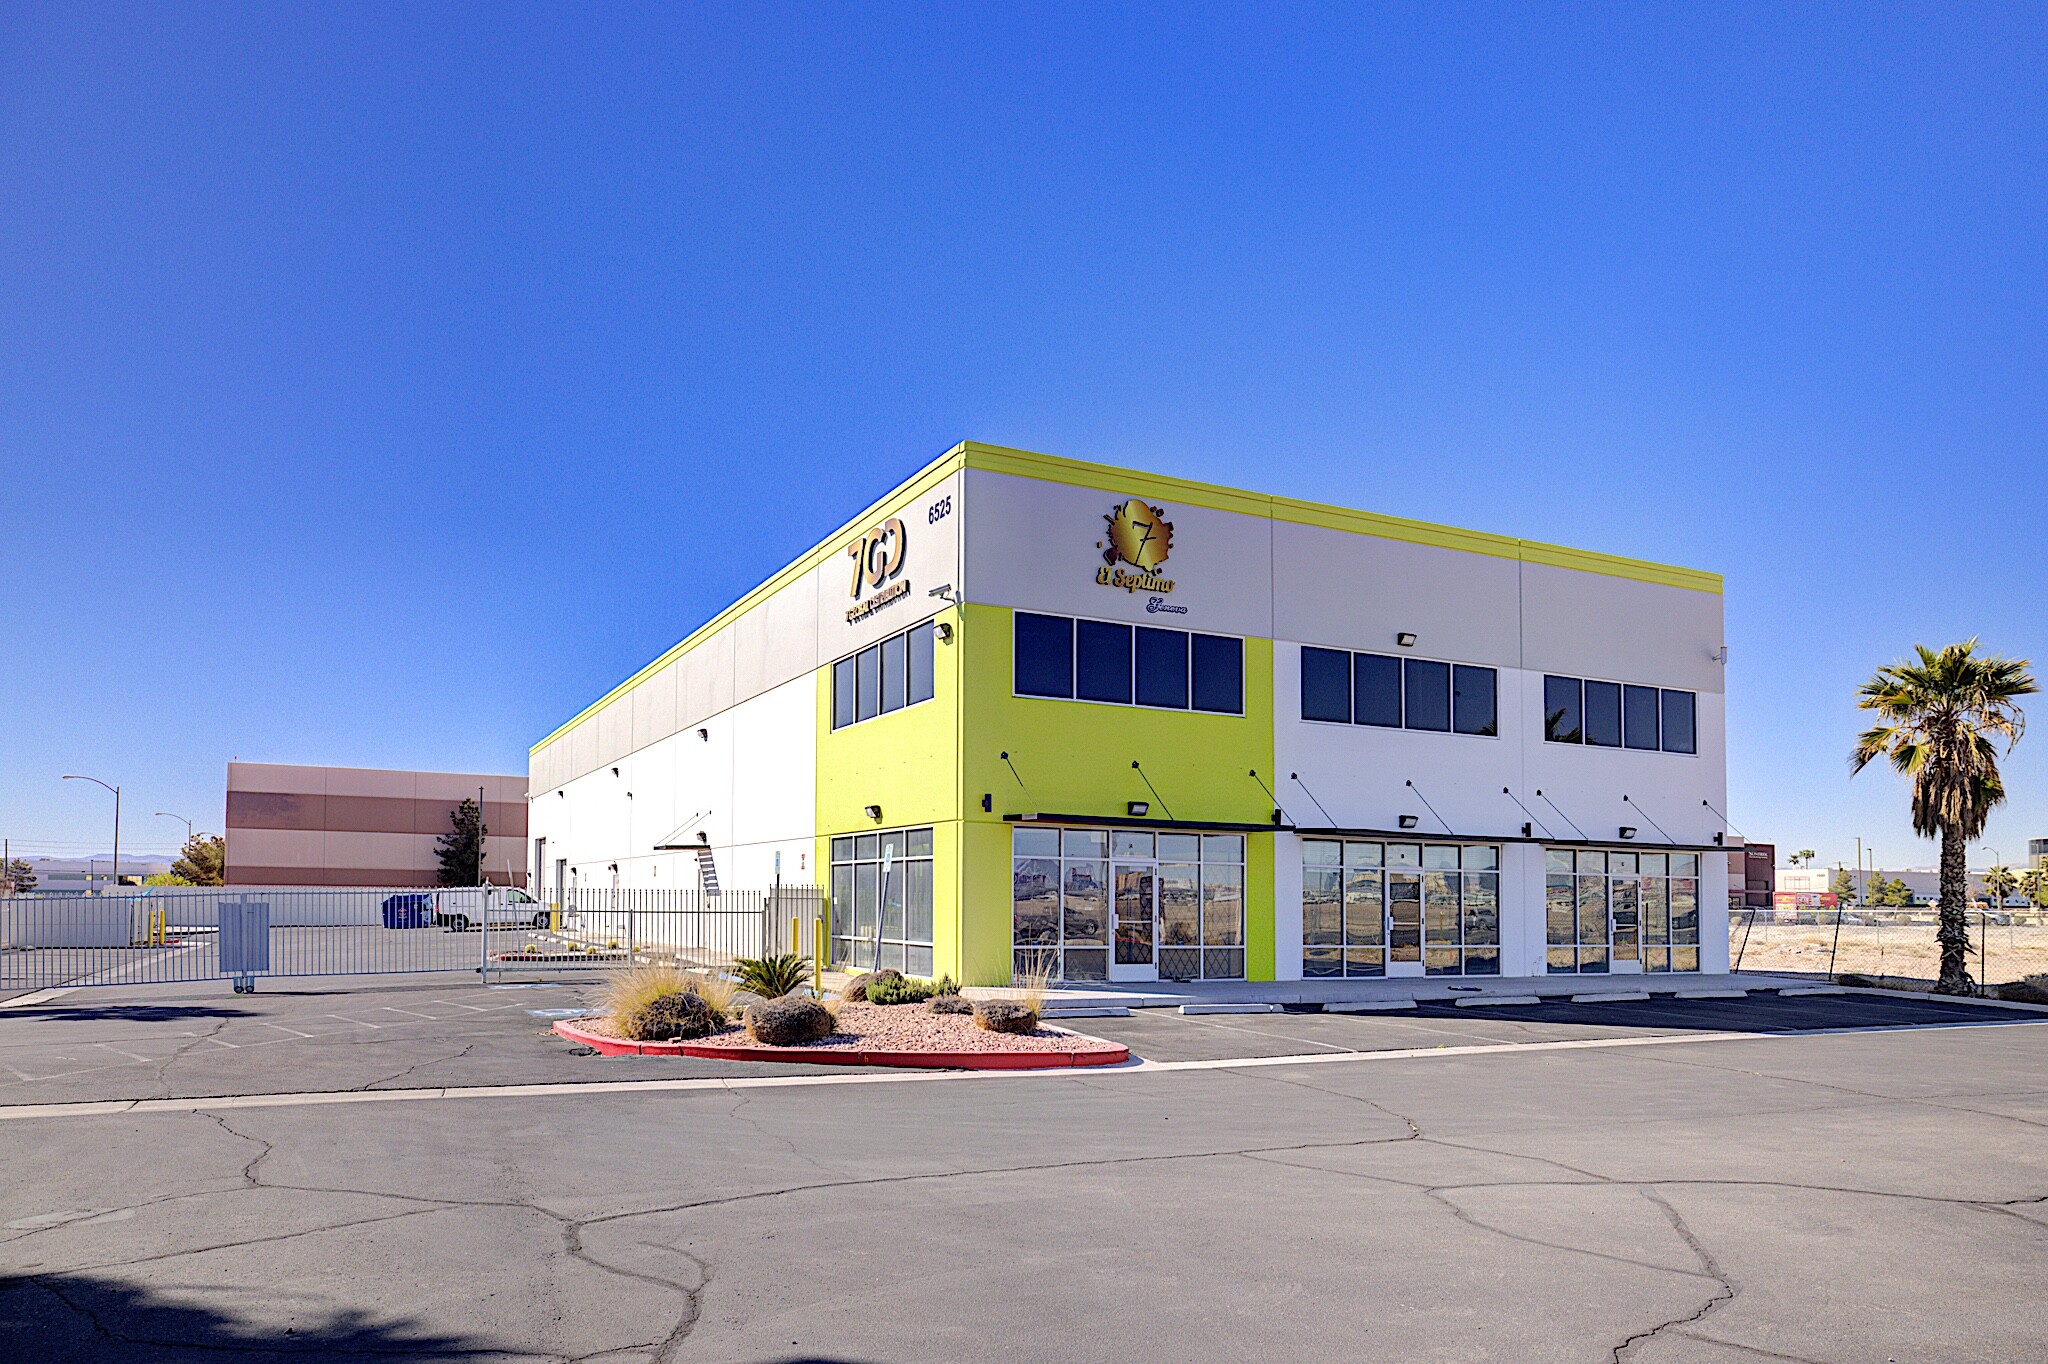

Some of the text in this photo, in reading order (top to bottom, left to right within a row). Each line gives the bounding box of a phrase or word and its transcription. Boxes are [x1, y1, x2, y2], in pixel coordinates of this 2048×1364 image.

[928, 495, 951, 525] 6525
[1132, 520, 1157, 565] 7
[1097, 566, 1175, 593] El Septimo
